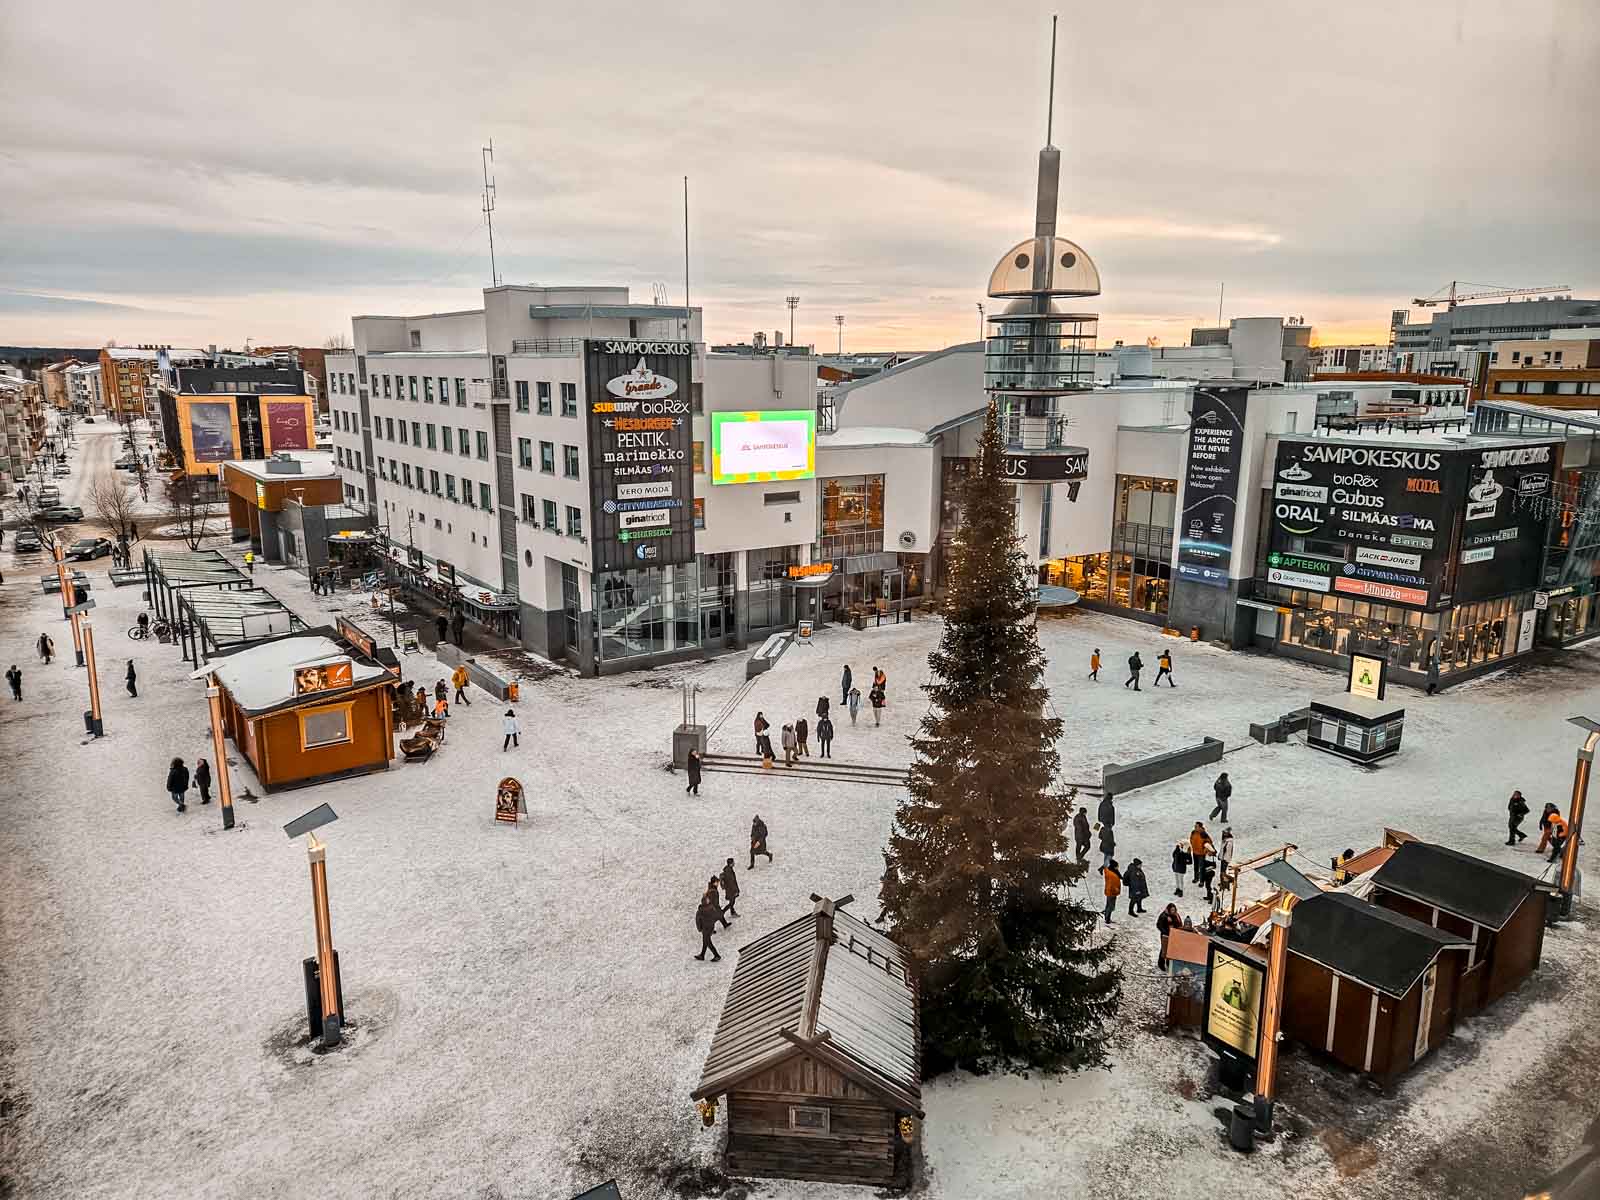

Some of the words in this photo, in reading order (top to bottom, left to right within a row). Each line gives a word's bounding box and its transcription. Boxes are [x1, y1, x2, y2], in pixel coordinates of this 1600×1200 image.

[606, 342, 690, 355] SAMPOKESKUS
[592, 401, 639, 413] SUBWAY
[1195, 428, 1233, 437] EXPERIENCE
[1207, 437, 1230, 445] ARCTIC
[604, 449, 684, 462] marimekko
[1208, 445, 1230, 453] NEVER
[1192, 452, 1216, 460] BEFORE
[1302, 446, 1441, 470] SAMPOKESKUS
[645, 486, 669, 494] MODA
[1332, 489, 1384, 508] Cubus
[1275, 504, 1324, 523] ORAL
[1338, 530, 1386, 543] Danske
[1283, 557, 1330, 572] APTEEKKI
[1358, 552, 1380, 560] JACK
[1387, 555, 1415, 566] JONES
